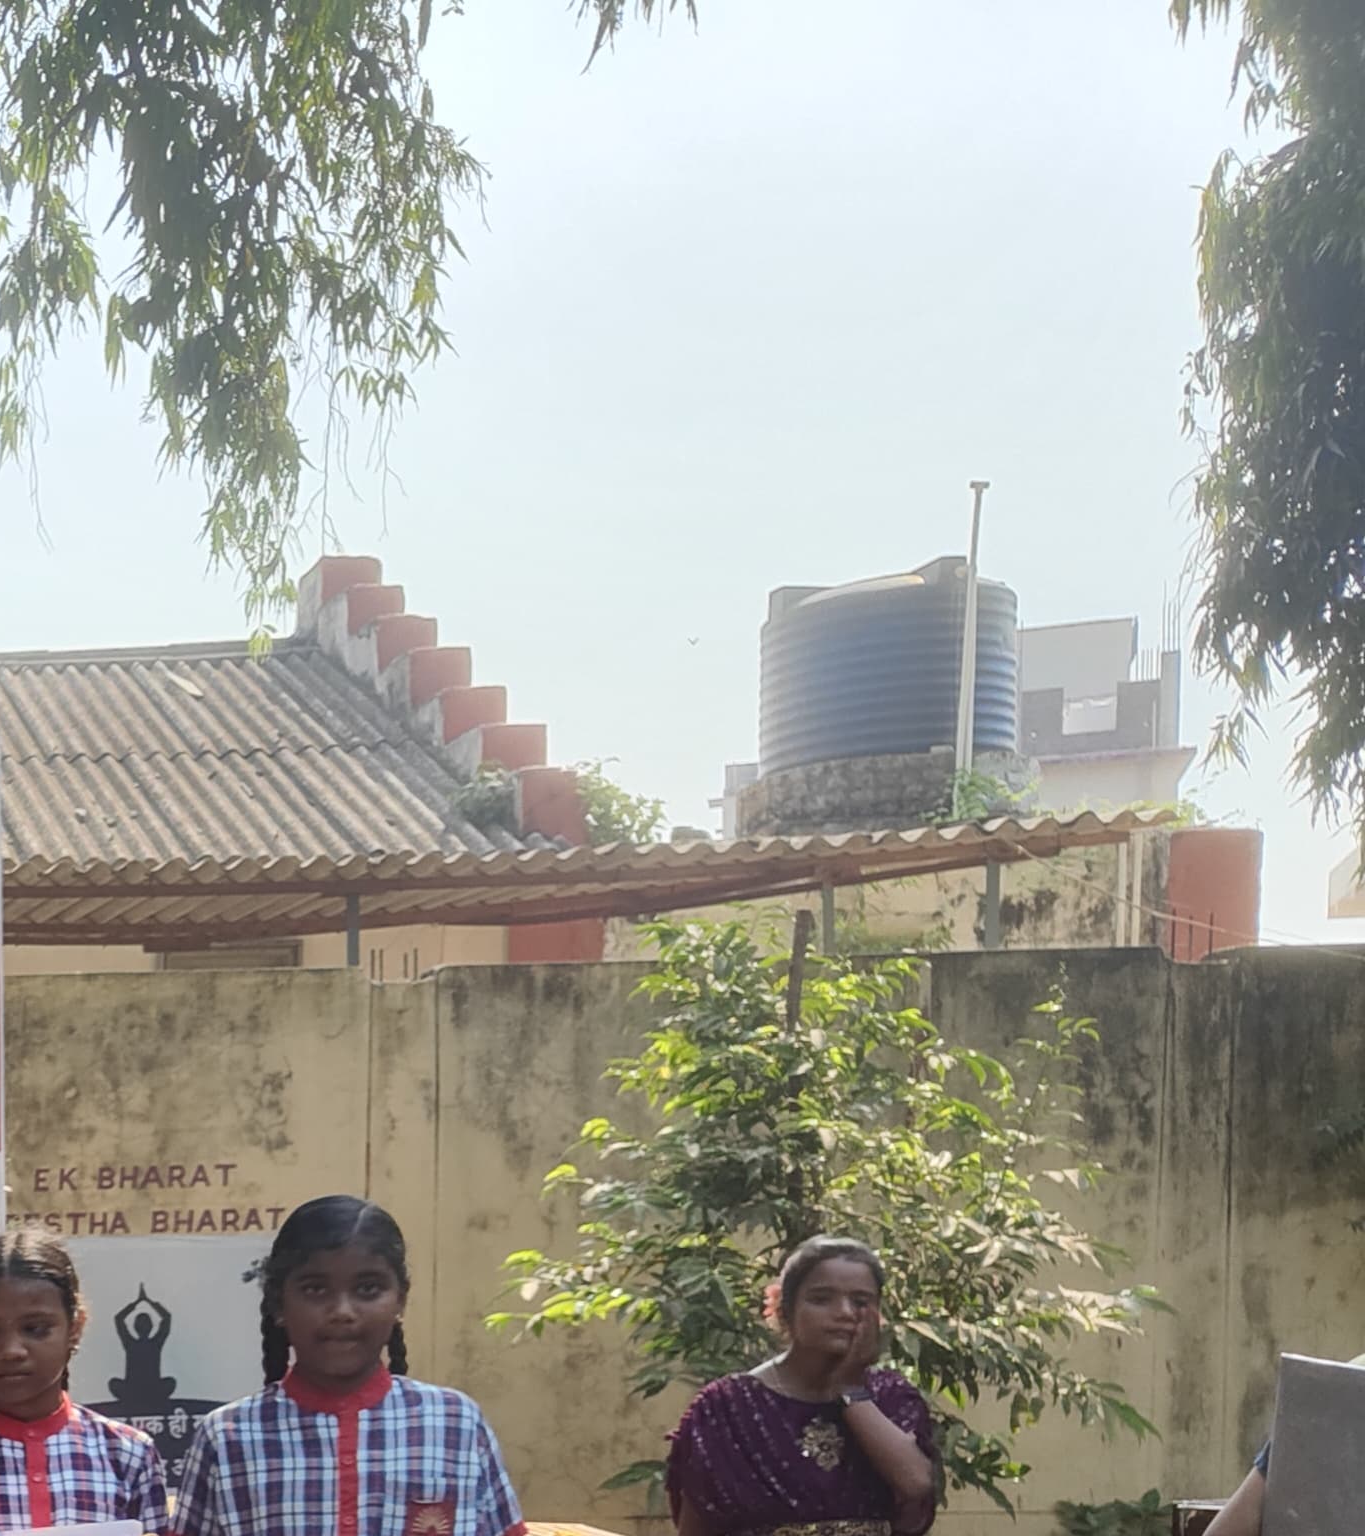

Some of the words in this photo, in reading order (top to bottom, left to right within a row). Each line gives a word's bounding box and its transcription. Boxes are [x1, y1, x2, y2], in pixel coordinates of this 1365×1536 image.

[33, 1167, 78, 1193] EK
[96, 1163, 238, 1191] BHARAT
[150, 1208, 285, 1234] BHARAT
[167, 1407, 189, 1439] ही
